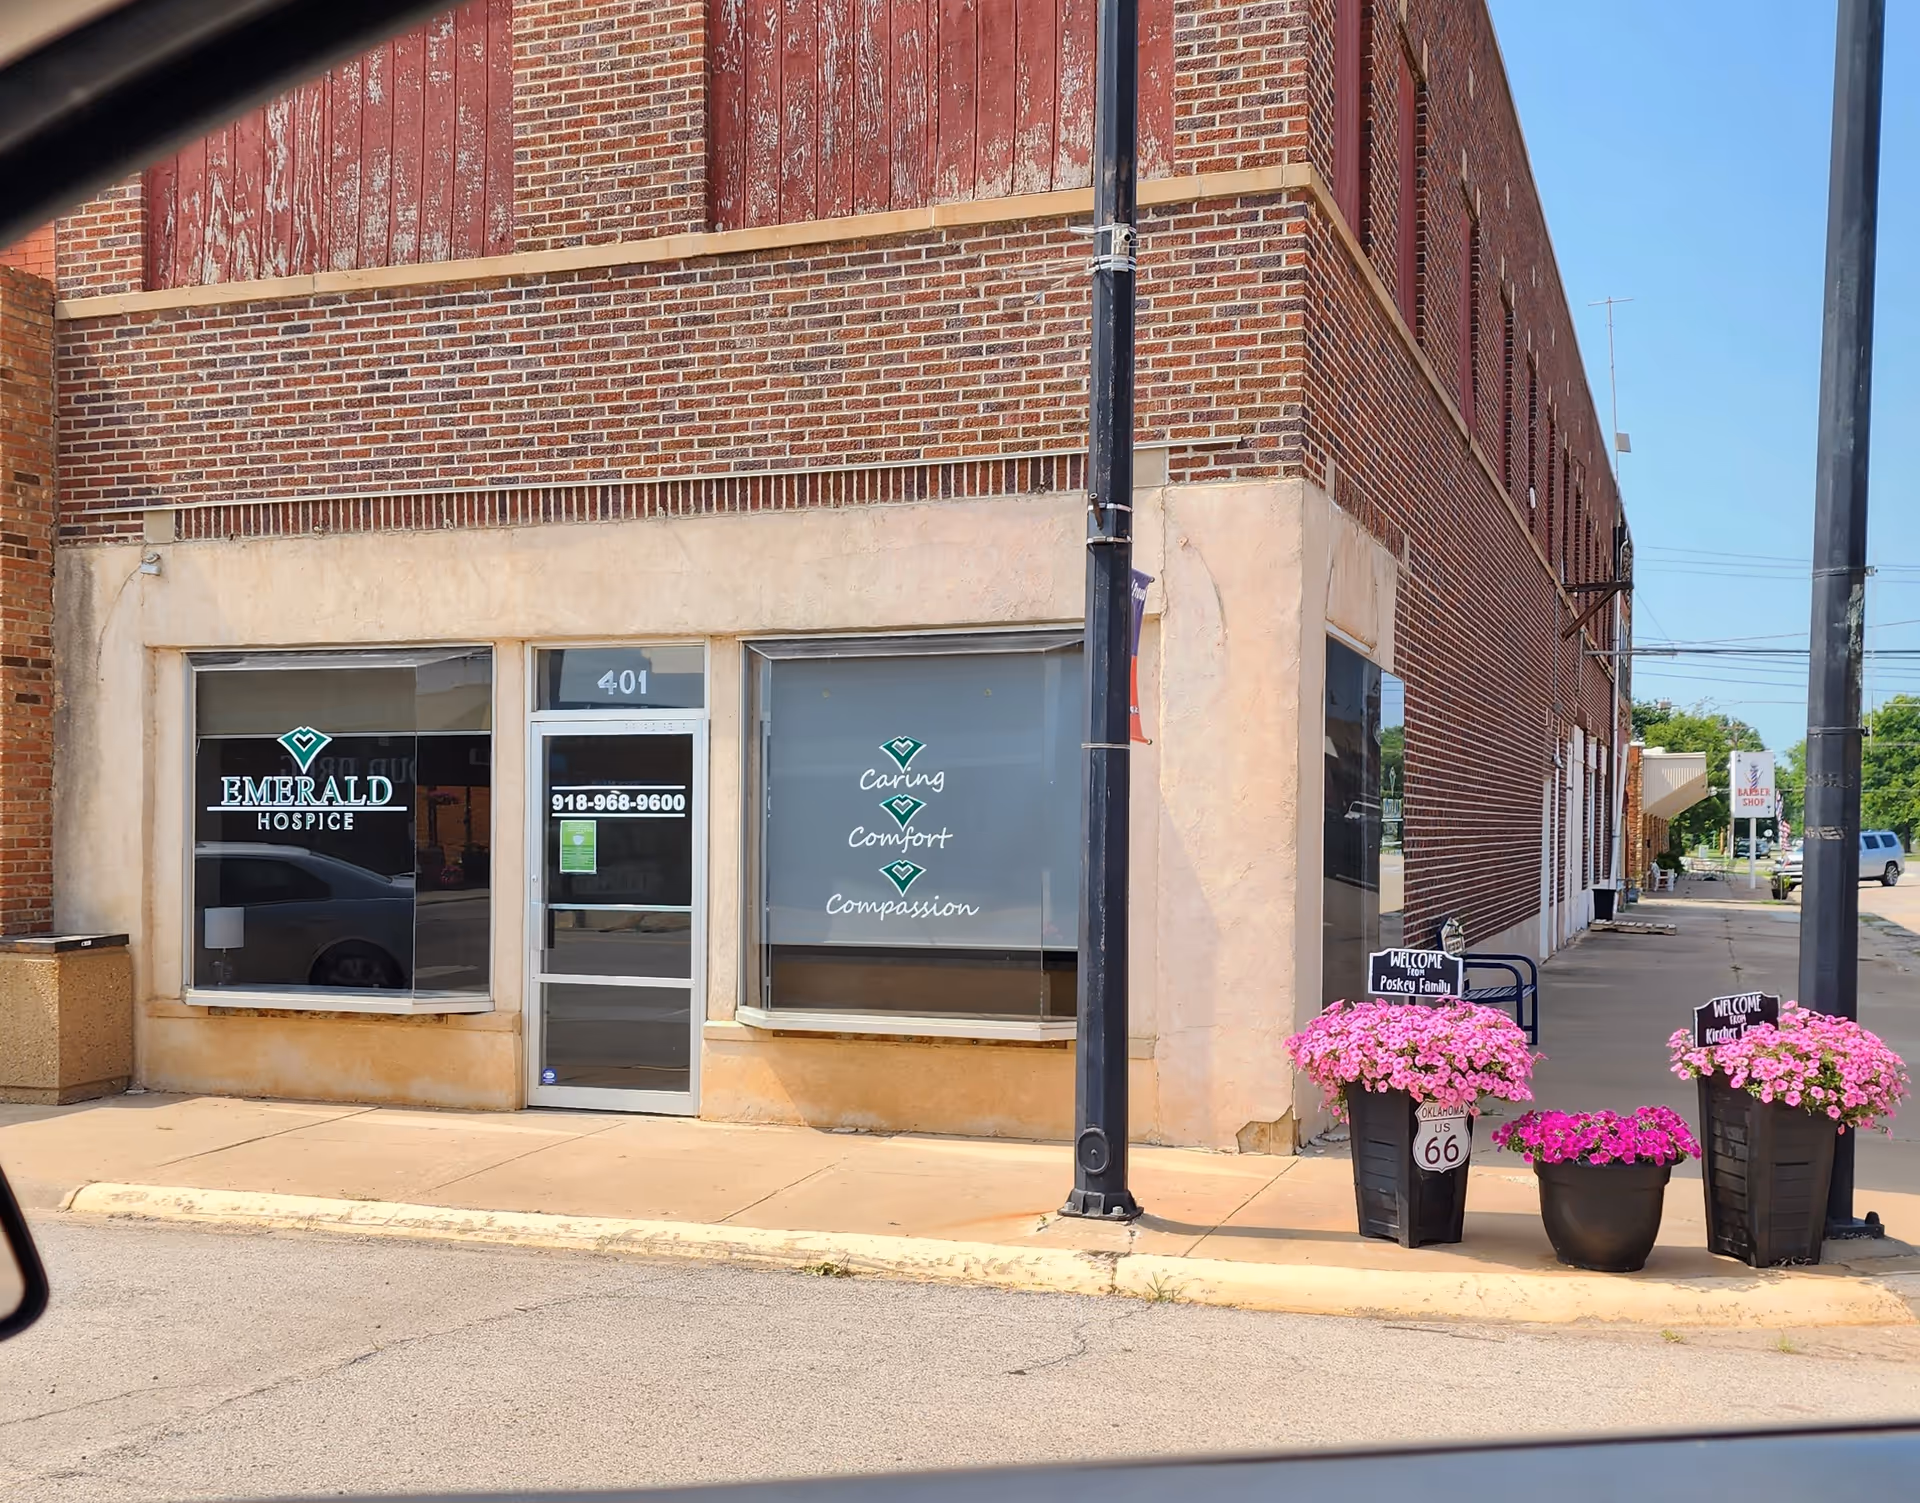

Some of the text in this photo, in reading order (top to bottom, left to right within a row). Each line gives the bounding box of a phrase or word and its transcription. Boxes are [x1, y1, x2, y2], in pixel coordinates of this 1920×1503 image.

[597, 669, 648, 695] 401
[860, 766, 945, 793] Caring
[220, 775, 393, 806] EMERALD
[1737, 787, 1770, 796] BARBER
[551, 793, 686, 811] 918-968-9600
[1742, 797, 1765, 806] SHOP
[257, 812, 354, 831] HOSPICE
[848, 825, 954, 853] Comfort
[826, 893, 980, 920] Compassion
[1389, 951, 1443, 969] WELCOME
[1407, 968, 1425, 977] FROM
[1380, 975, 1451, 995] Poskey Family
[1713, 994, 1762, 1018] WELCOME
[1729, 1014, 1747, 1025] FROM
[1434, 1123, 1451, 1133] US
[1424, 1134, 1459, 1165] 66
